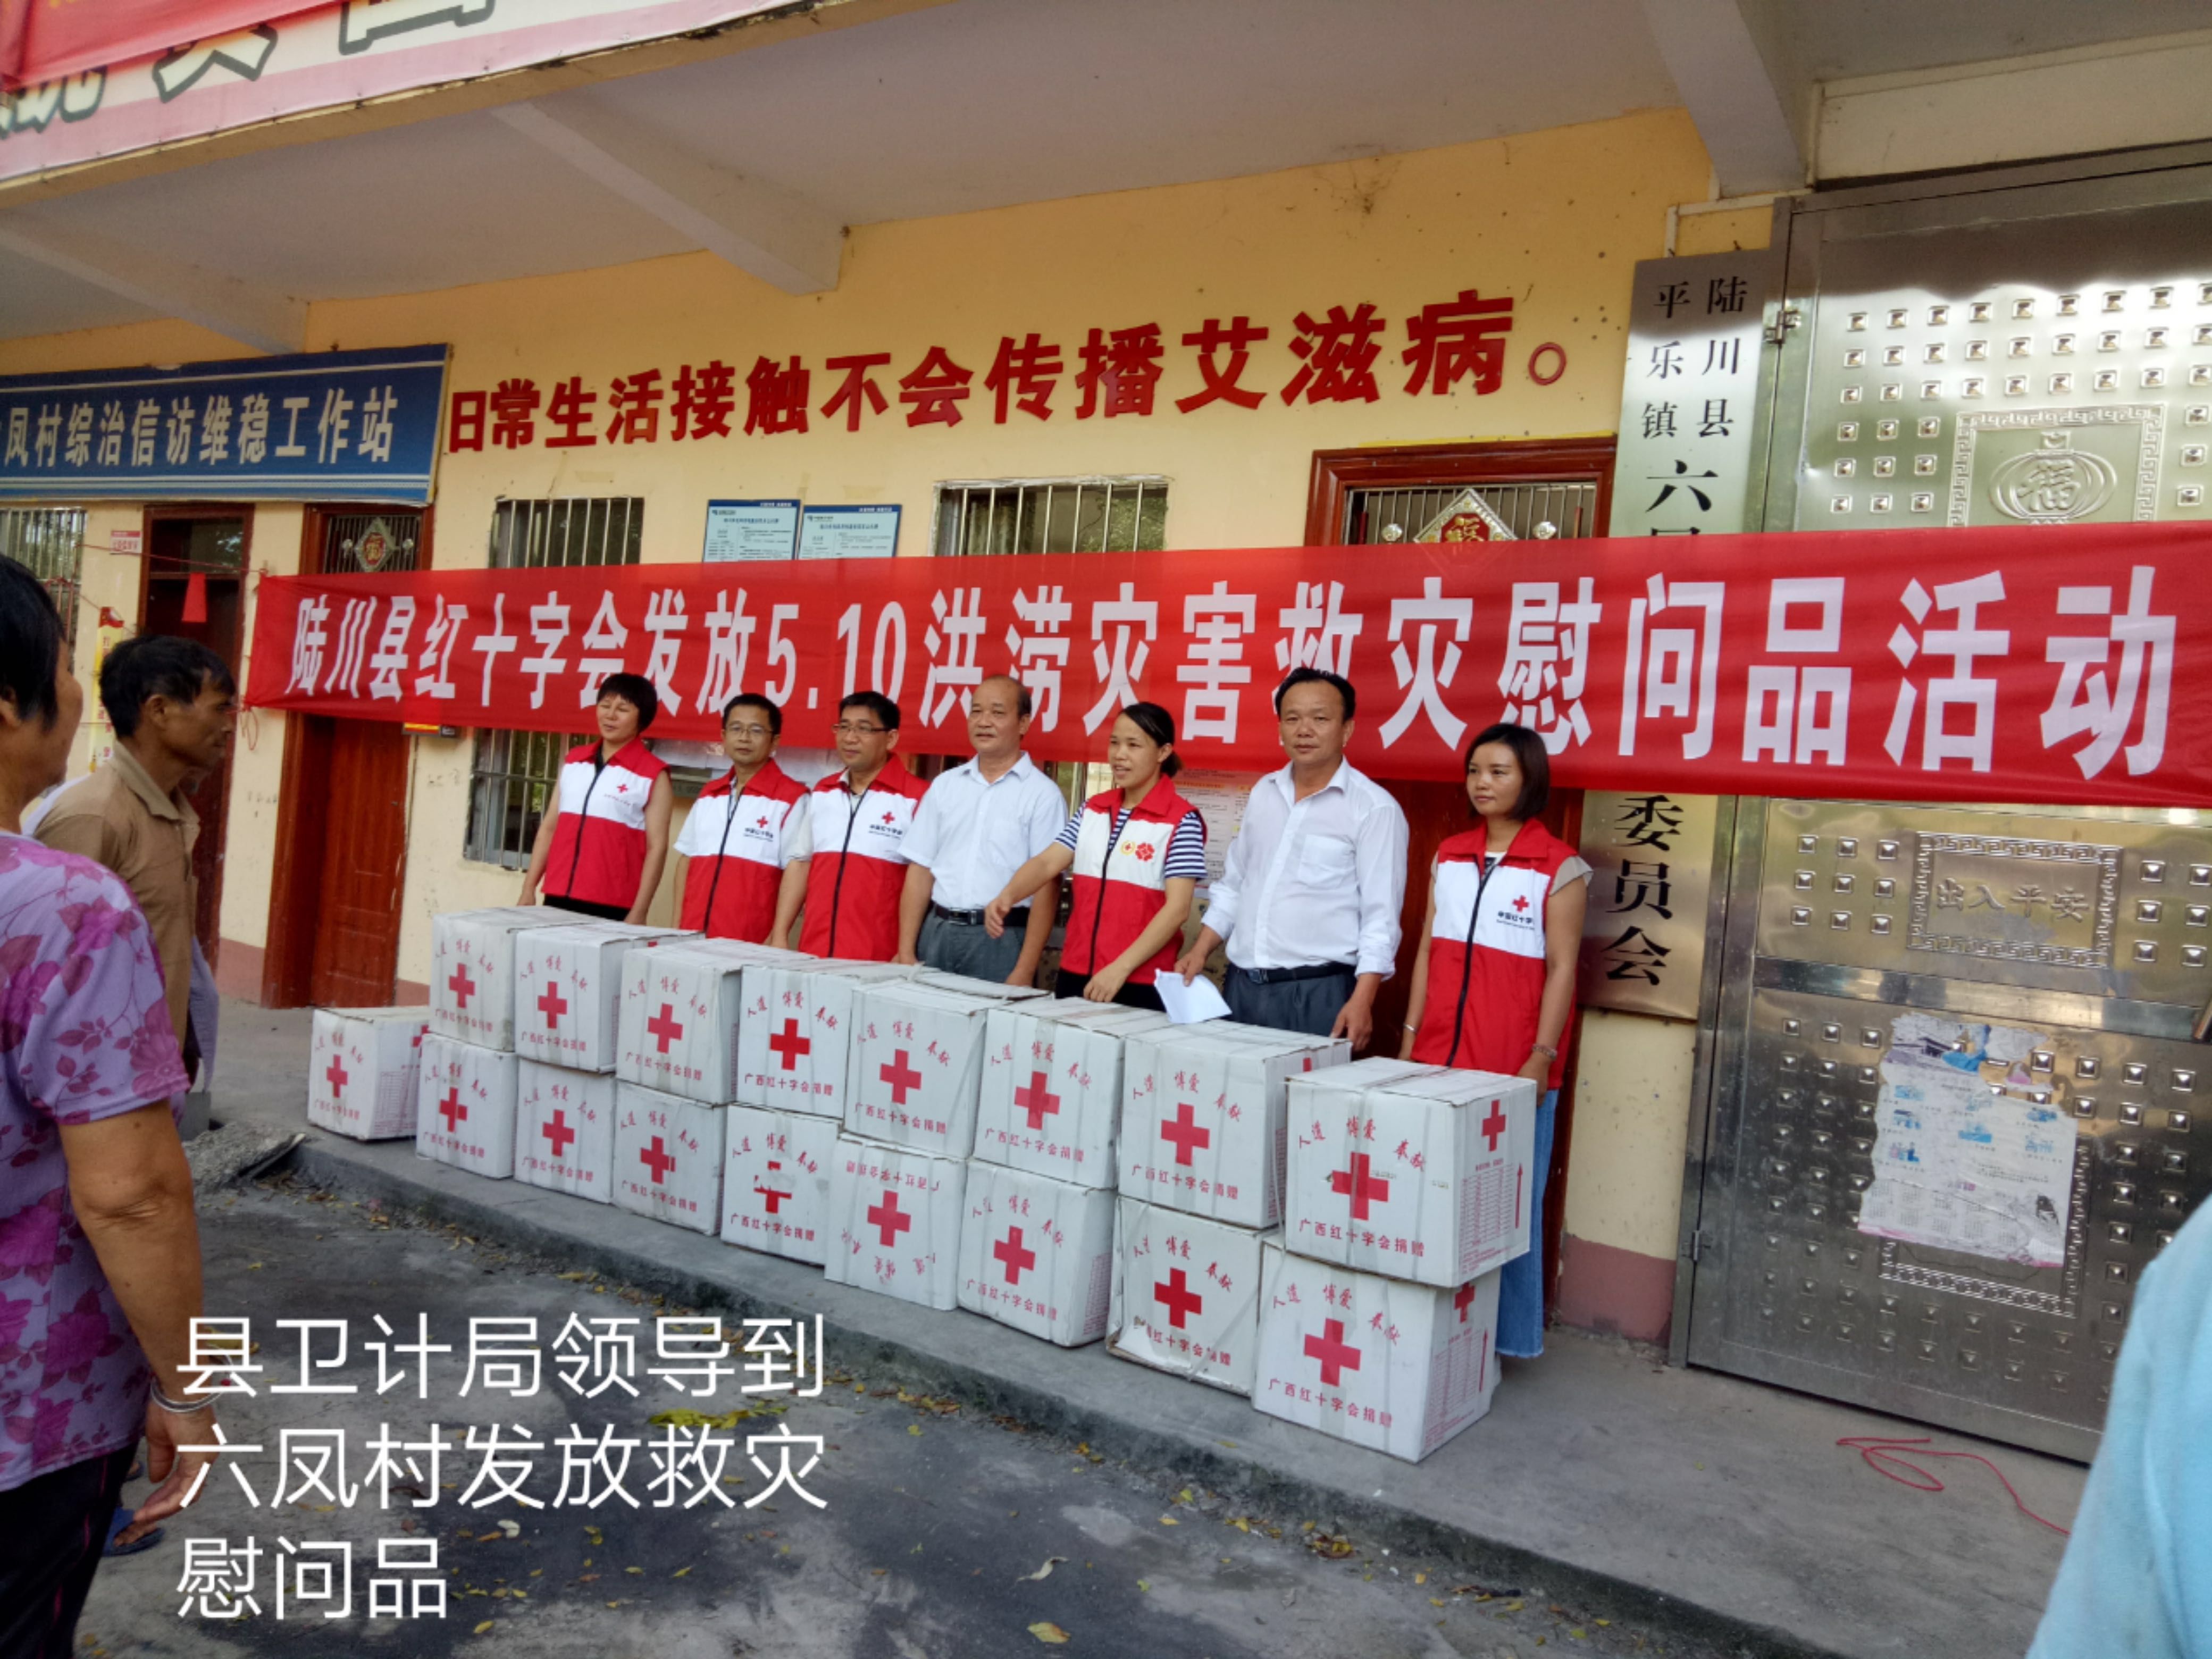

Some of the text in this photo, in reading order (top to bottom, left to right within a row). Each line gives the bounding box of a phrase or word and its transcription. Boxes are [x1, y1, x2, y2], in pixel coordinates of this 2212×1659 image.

[449, 289, 1566, 453] 日常生活接触不会传播艾滋病。
[1641, 281, 1690, 439] 平乐镇
[1696, 276, 1748, 438] 陆川县
[0, 386, 398, 466] 凤村综治信访维稳工作站
[1601, 795, 1684, 986] 委员会
[1936, 878, 2090, 923] 出入平安
[1498, 911, 1534, 925] 中国红十字
[744, 1073, 834, 1096] 广西红十字会捐赠
[985, 1128, 1085, 1163] 广西红十字会捐赠
[1346, 1116, 1377, 1142] 博爱
[1132, 1164, 1239, 1200] 广西红十字会捐赠
[1298, 1218, 1426, 1257] 广西红十字会捐赠
[1322, 1284, 1353, 1310] 博爱
[1269, 1378, 1393, 1428] 广西红十字会捐赠
